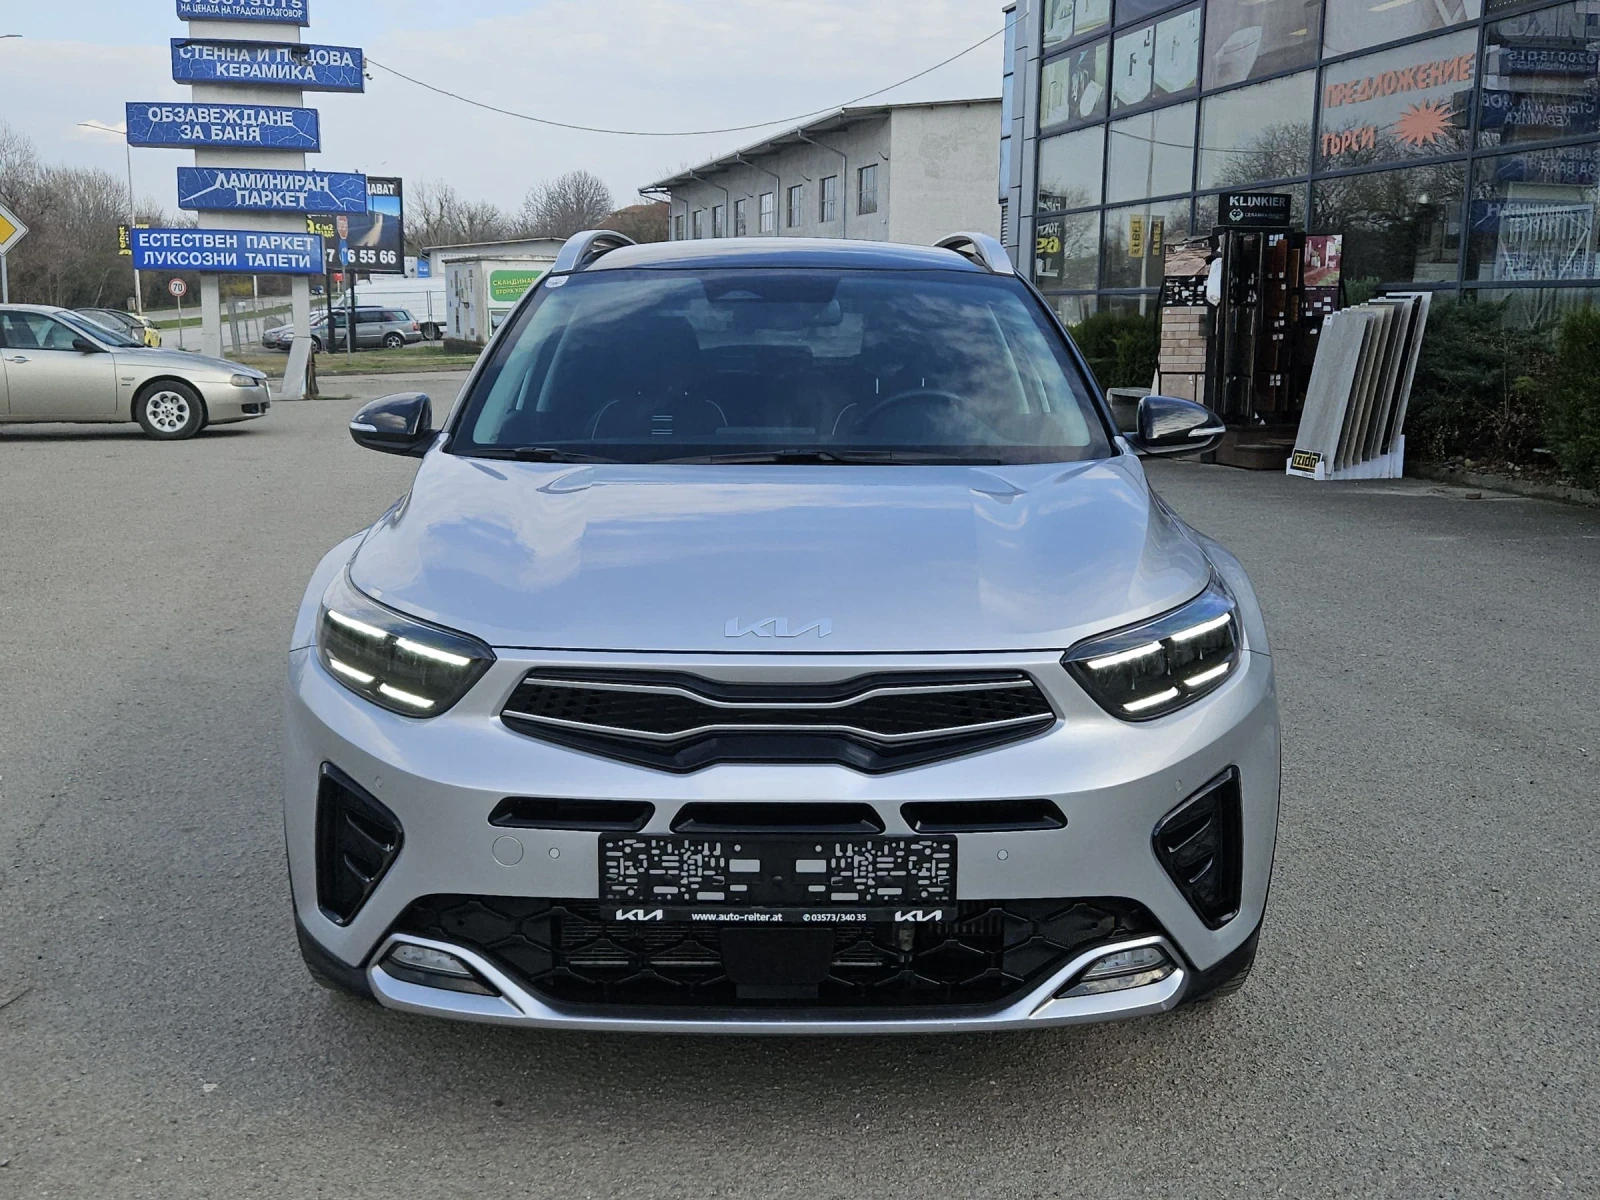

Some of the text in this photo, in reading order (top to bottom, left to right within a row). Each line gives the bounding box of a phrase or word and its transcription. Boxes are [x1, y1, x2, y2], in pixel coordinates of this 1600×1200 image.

[181, 3, 191, 12] НА
[193, 4, 220, 13] ЦЕНАТА
[221, 6, 231, 14] НА
[232, 6, 266, 16] ГРАДСКИ
[266, 8, 302, 18] РАЗГОВОР
[180, 46, 354, 67] СТЕННА И ПОВА
[216, 63, 316, 81] КЕРАМИКА
[1323, 52, 1476, 108] ПРЕДЛОЖЕНИЕ
[148, 107, 293, 126] ОБЗАВЕЖДАНЕ
[180, 126, 260, 142] ЗА БАНЯ
[214, 173, 329, 192] ЛАМИНИРАН
[236, 190, 308, 207] ПАРКЕТ
[1230, 196, 1286, 206] KLINKIER
[139, 234, 238, 248] ЕСТЕСТВЕН
[246, 236, 314, 250] ПАРКЕТ
[144, 252, 310, 268] ЛУКСОЗНИ ТАПЕТИ
[360, 250, 376, 264] 55
[380, 250, 396, 264] 66
[173, 283, 182, 291] 70
[692, 912, 782, 922] www.auto-reiter.at
